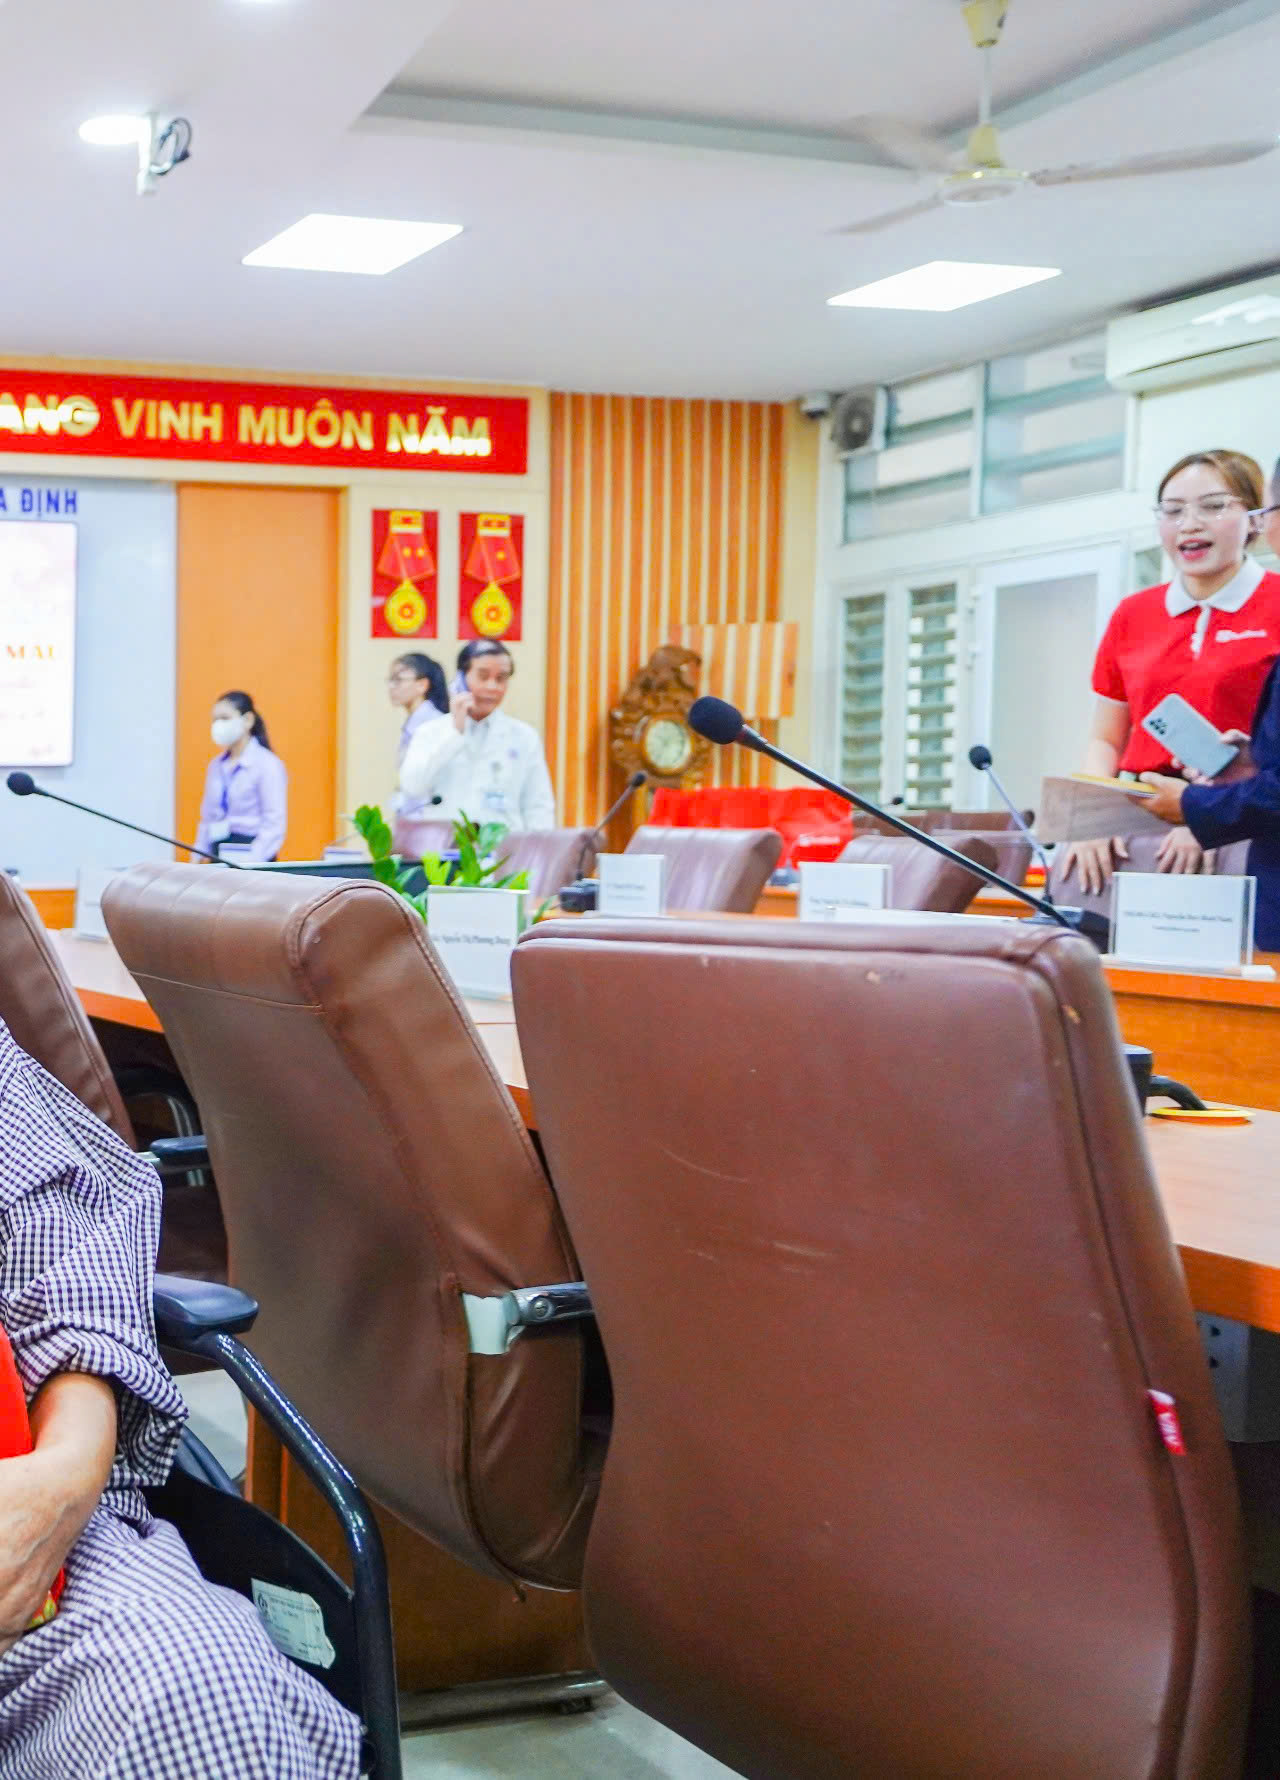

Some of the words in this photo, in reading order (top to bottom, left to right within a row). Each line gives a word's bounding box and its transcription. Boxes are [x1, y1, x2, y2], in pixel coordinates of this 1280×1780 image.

[113, 398, 222, 442] VINH
[238, 398, 374, 451] MUÔN
[386, 405, 492, 457] NĂM
[21, 488, 78, 518] ĐỊNH
